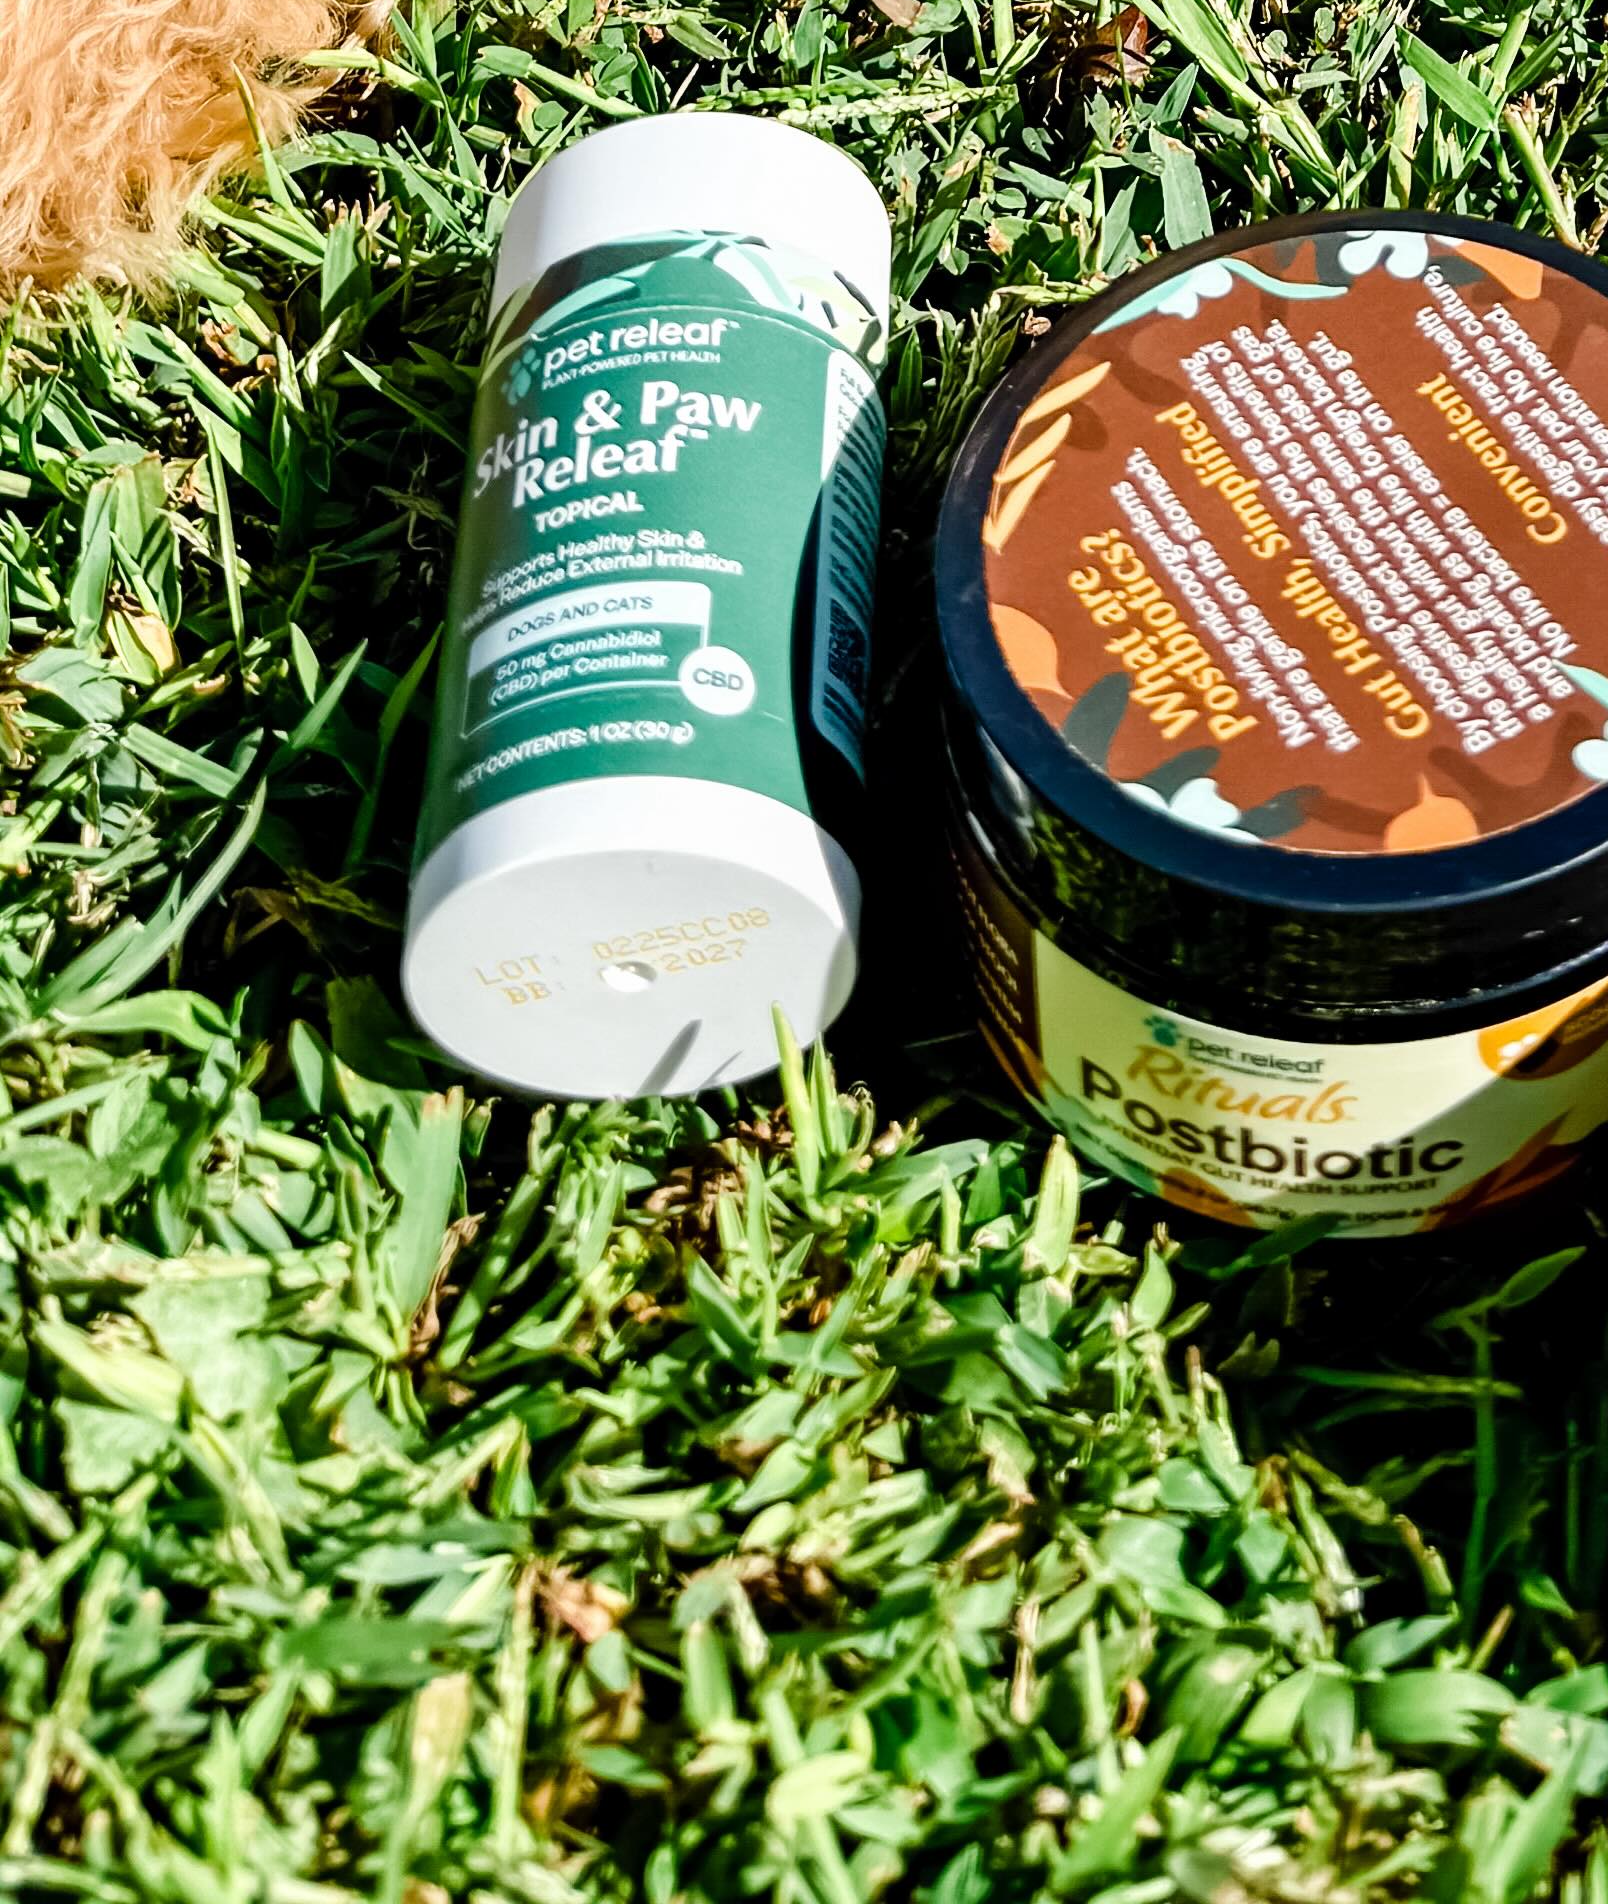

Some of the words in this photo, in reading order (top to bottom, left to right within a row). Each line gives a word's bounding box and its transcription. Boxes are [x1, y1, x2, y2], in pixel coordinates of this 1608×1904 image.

[1422, 265, 1484, 337] culture,
[542, 333, 602, 376] pet
[643, 351, 667, 364] PET
[670, 351, 720, 363] HEALTH
[1199, 341, 1232, 363] of
[1231, 325, 1275, 362] gas
[1307, 330, 1353, 370] gut.
[1415, 305, 1474, 370] health
[1476, 334, 1514, 373] live
[1484, 303, 1557, 381] needed.
[1251, 362, 1285, 385] of
[1264, 318, 1337, 408] bacteria.
[1336, 369, 1373, 406] the
[1505, 368, 1538, 404] No
[1180, 356, 1252, 439] ensuring
[1222, 362, 1293, 445] benefits
[1274, 383, 1321, 432] risks
[1459, 363, 1510, 416] tract
[473, 416, 558, 499] Skin
[575, 389, 622, 436] &
[640, 381, 762, 431] Paw
[1324, 401, 1389, 478] foreign
[1361, 402, 1393, 432] on
[1528, 398, 1576, 441] pet.
[1153, 400, 1292, 559] Simplified
[1241, 437, 1280, 475] are
[1280, 441, 1318, 481] the
[1309, 432, 1361, 490] same
[1382, 434, 1440, 494] easier
[1415, 372, 1567, 543] Convenient
[1501, 410, 1583, 499] digestive
[534, 491, 644, 533] TOPICAL
[1125, 447, 1204, 542] stomach.
[1266, 473, 1315, 517] you
[1351, 487, 1389, 526] the
[1376, 474, 1418, 515] live
[557, 533, 634, 560] Healthy
[637, 529, 684, 549] Skin
[687, 530, 705, 549] &
[1306, 477, 1382, 564] receives
[1404, 509, 1450, 556] with
[1110, 480, 1240, 641] microorganisms
[1189, 539, 1229, 578] the
[1300, 512, 1398, 633] Postbiotics,
[1375, 521, 1450, 597] without
[1441, 552, 1473, 579] as
[1442, 506, 1521, 592] bacteria
[500, 566, 564, 605] Reduce
[567, 551, 651, 577] External
[656, 551, 743, 575] Irritation
[1068, 566, 1128, 626] are
[1215, 575, 1248, 604] on
[1368, 561, 1421, 613] tract
[507, 612, 555, 641] DOGS
[559, 601, 600, 621] AND
[603, 596, 653, 613] CATS
[1281, 557, 1382, 676] Health,
[1435, 594, 1484, 631] gut
[1462, 573, 1541, 661] bloating
[1508, 585, 1553, 628] live
[521, 652, 546, 669] mg
[549, 631, 661, 660] Cannabidiol
[1080, 529, 1259, 741] Postbiotics?
[1236, 604, 1306, 670] gentle
[1409, 609, 1496, 700] digestive
[1538, 621, 1579, 659] No
[489, 673, 537, 706] (CBD)
[541, 662, 570, 685] per
[574, 652, 668, 675] Container
[693, 668, 744, 691] CBD
[1105, 627, 1200, 740] What
[1224, 636, 1317, 750] Non-living
[1286, 668, 1326, 705] are
[1384, 622, 1472, 720] choosing
[1466, 630, 1541, 709] healthy
[1521, 655, 1576, 699] and
[1309, 703, 1361, 753] that
[1362, 670, 1430, 739] Gut
[1483, 698, 1527, 739] the
[1527, 703, 1555, 721] a
[1457, 718, 1498, 754] By
[1186, 1038, 1232, 1059] pet
[1080, 1057, 1464, 1180] Postbiotic
